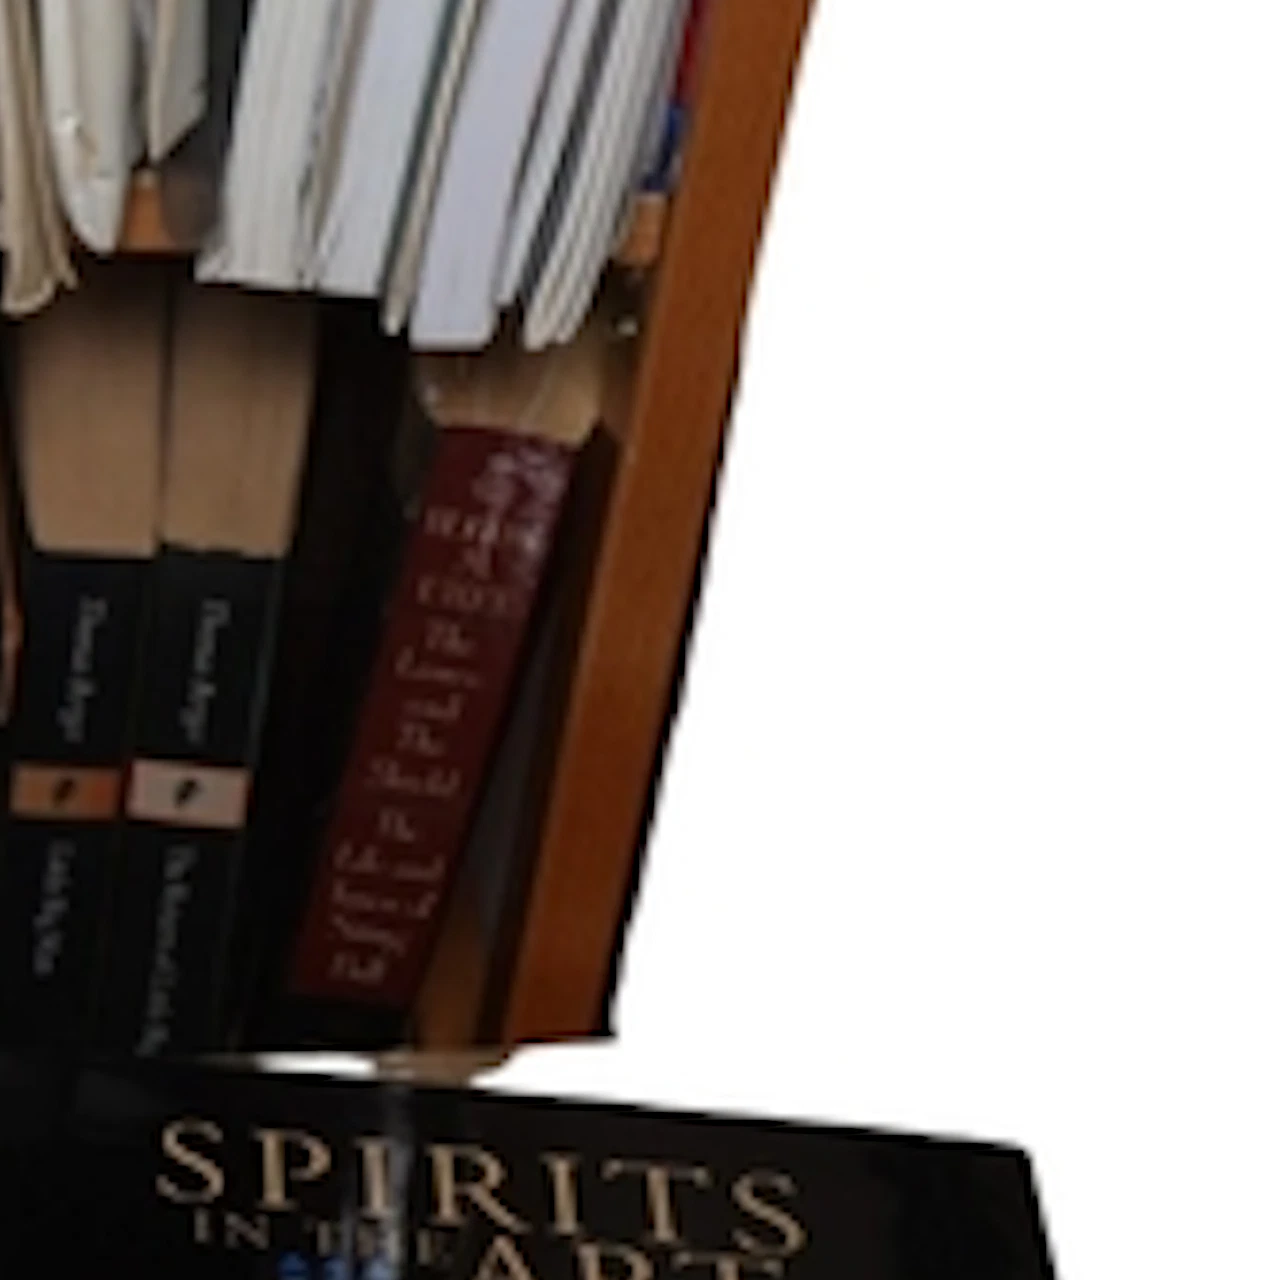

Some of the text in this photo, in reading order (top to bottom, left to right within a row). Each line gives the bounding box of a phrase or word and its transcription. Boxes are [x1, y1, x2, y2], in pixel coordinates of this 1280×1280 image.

[155, 1116, 810, 1260] SPIRITS
[192, 1206, 458, 1269] IN THE
